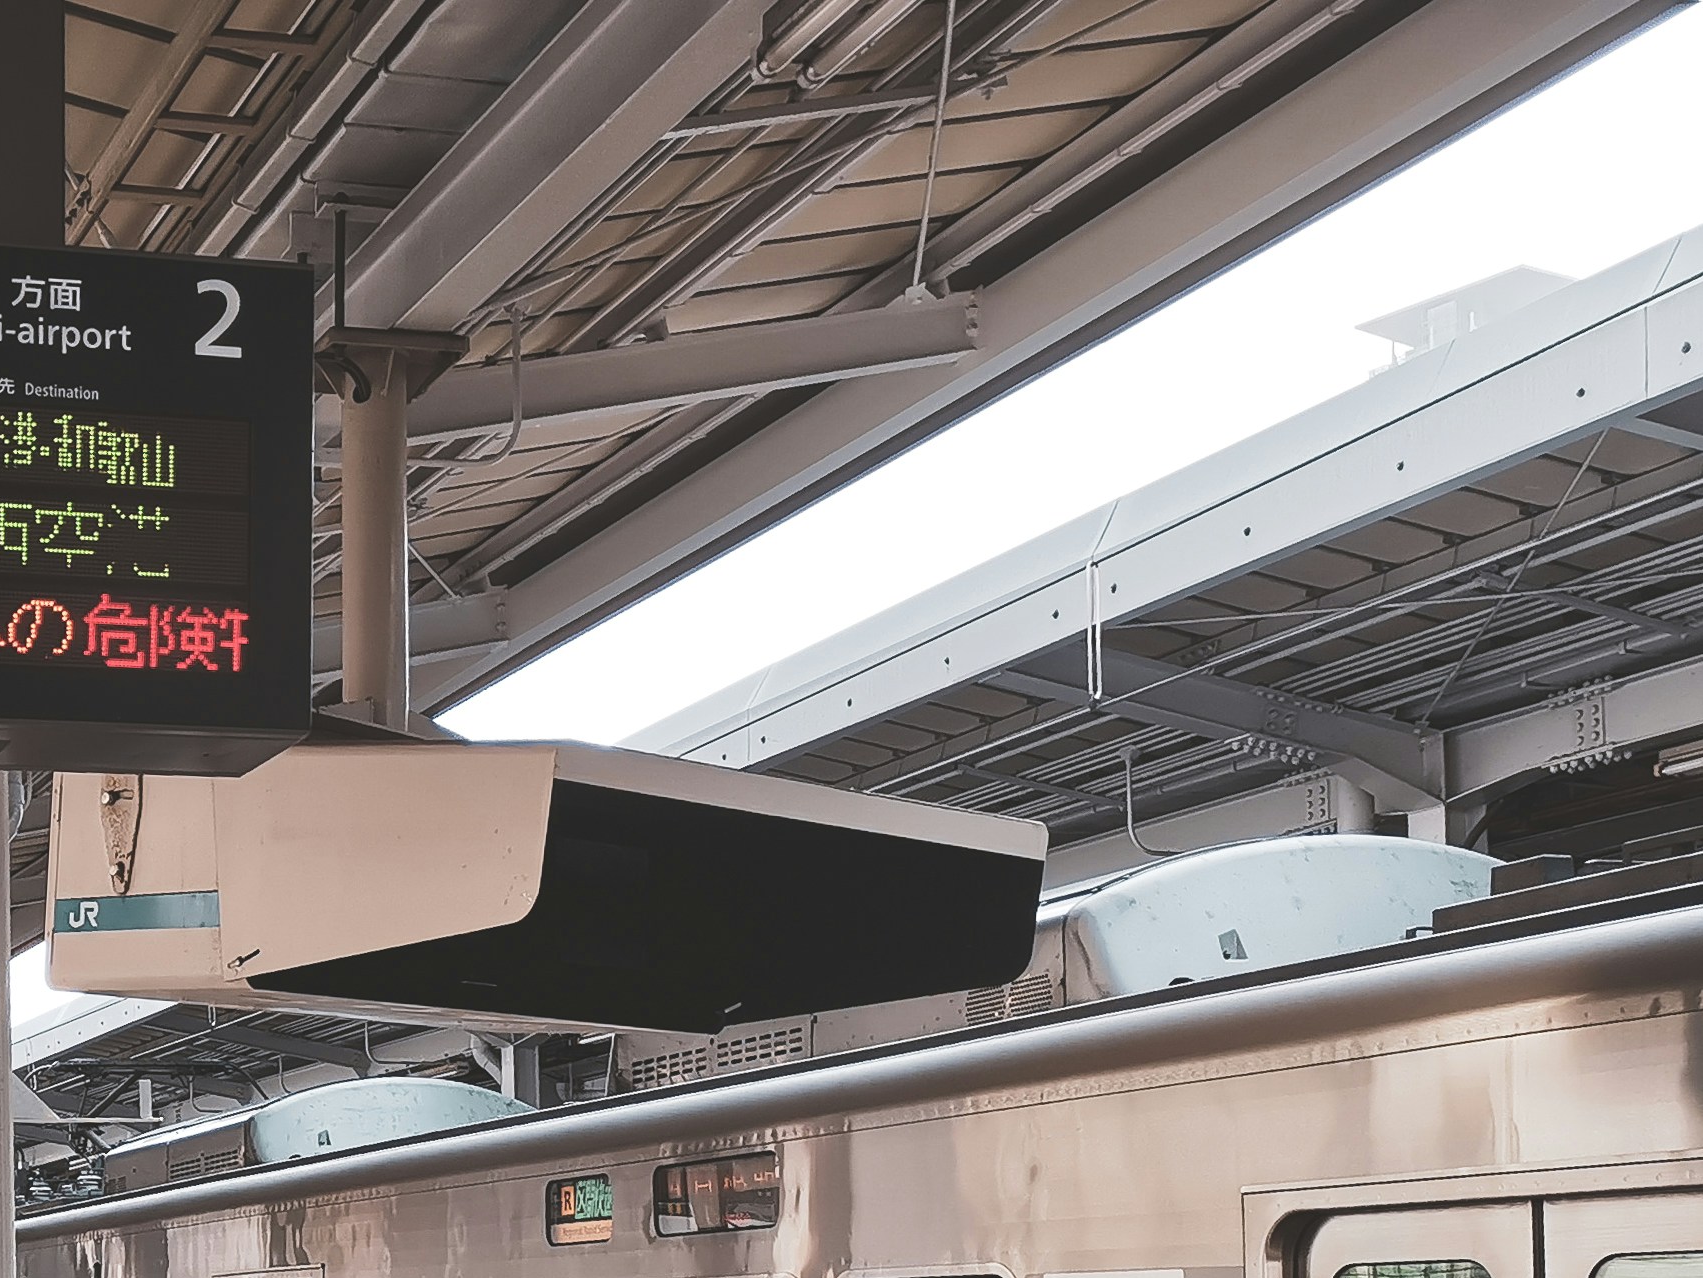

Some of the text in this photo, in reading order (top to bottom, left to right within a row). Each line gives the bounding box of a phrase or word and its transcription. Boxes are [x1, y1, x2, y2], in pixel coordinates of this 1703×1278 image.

[12, 275, 82, 311] 方面
[195, 279, 242, 358] 2
[25, 383, 98, 400] Destination
[69, 901, 99, 929] JR
